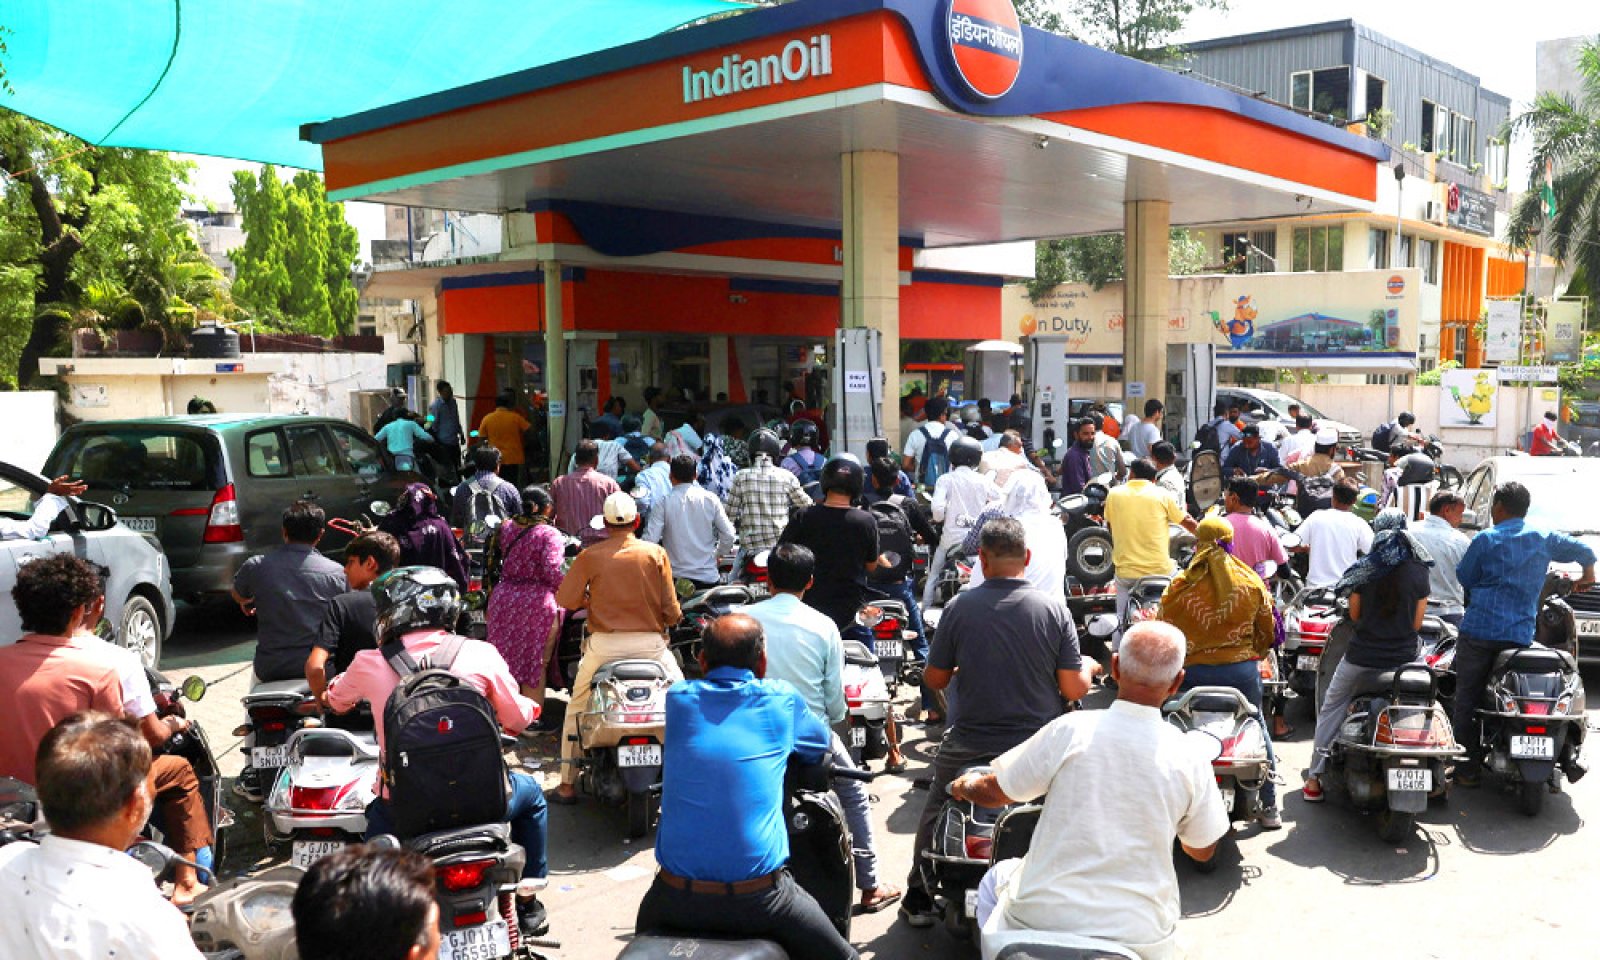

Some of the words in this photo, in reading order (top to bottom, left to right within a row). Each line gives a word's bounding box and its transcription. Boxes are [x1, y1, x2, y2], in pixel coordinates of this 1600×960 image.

[952, 15, 1020, 55] इंडियनऑयल
[682, 33, 833, 103] IndianOil
[1053, 317, 1092, 334] Duty,
